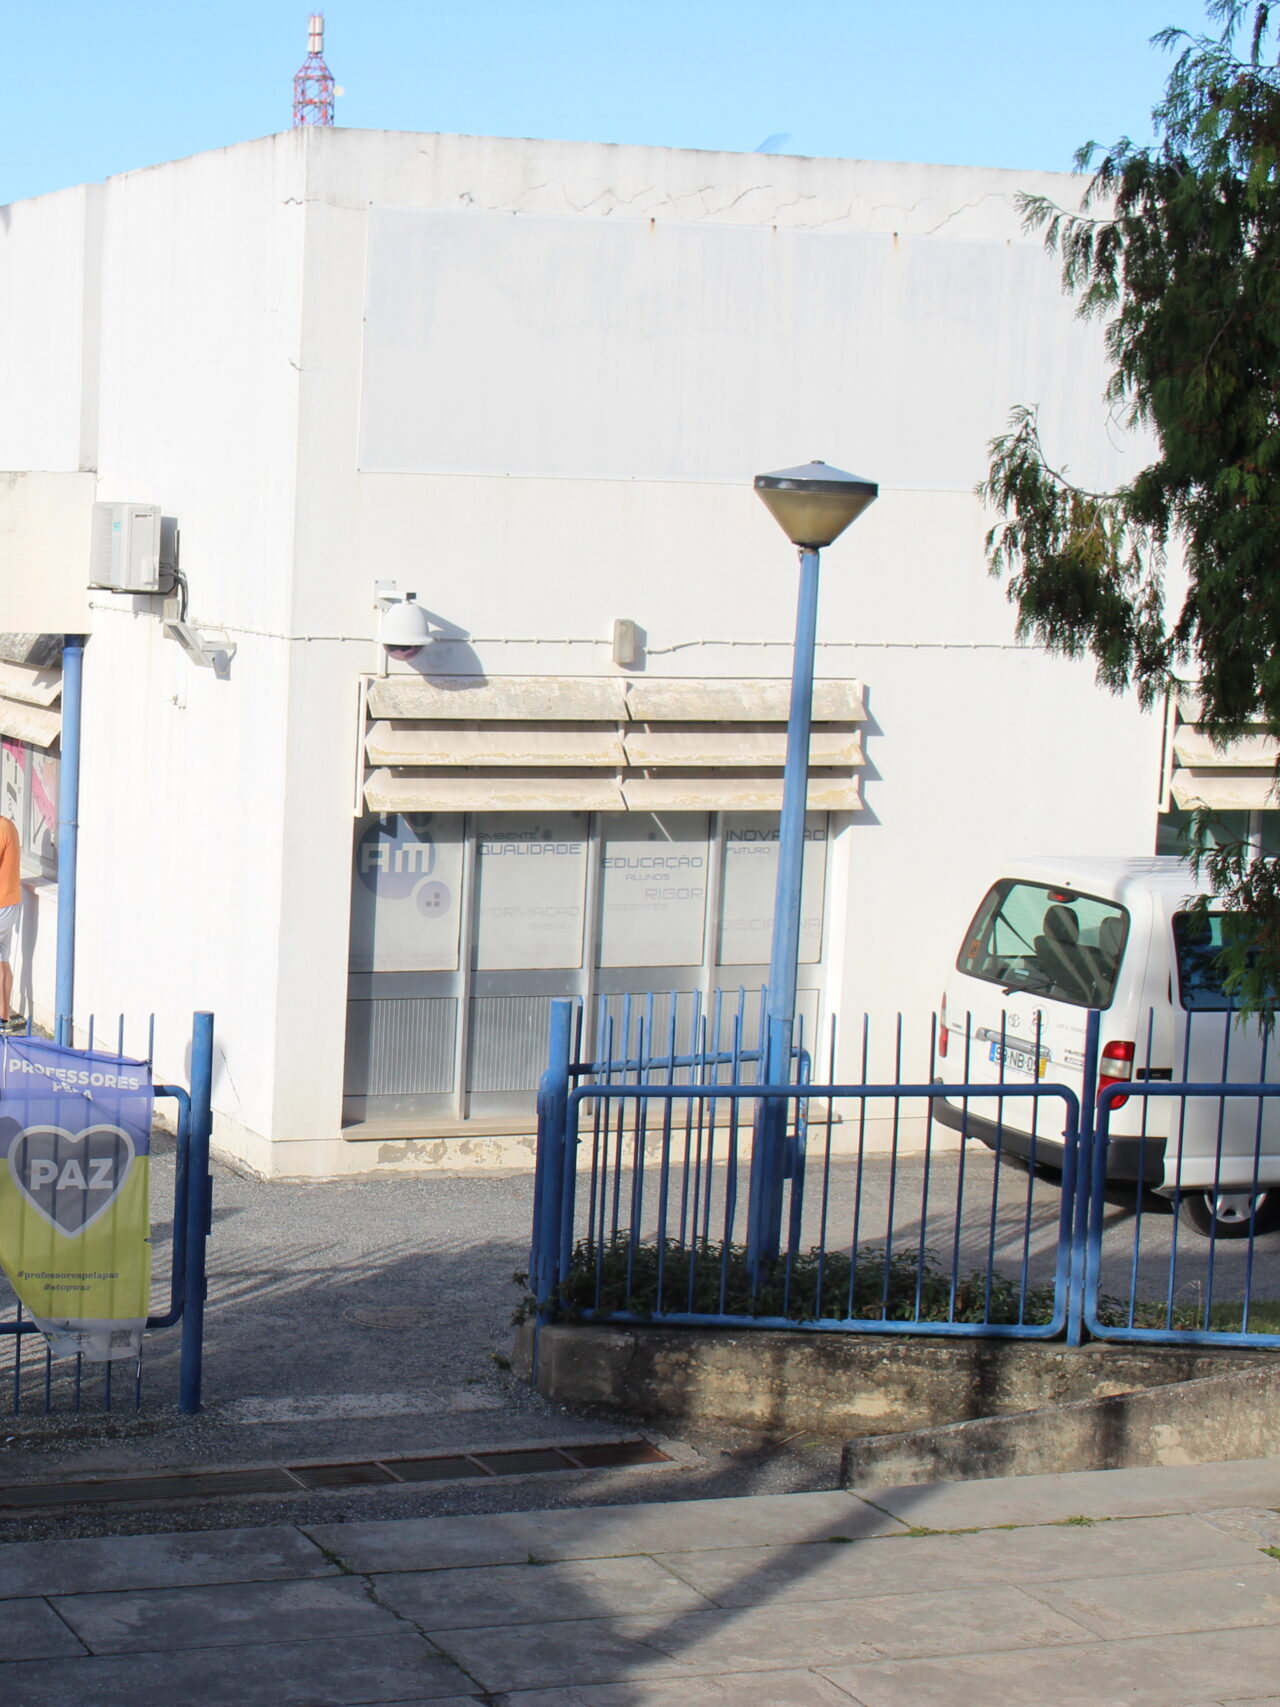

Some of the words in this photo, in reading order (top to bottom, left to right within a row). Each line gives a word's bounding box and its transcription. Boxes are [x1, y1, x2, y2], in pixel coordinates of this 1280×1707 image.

[476, 831, 537, 840] AMBIENTE
[476, 843, 581, 855] QUALIDADE
[601, 854, 703, 870] EDUCAÇÃO
[625, 873, 672, 881] ALUNOS
[644, 887, 703, 900] RIGOR
[9, 1058, 140, 1091] PROFESSORES
[29, 1158, 114, 1191] PAZ
